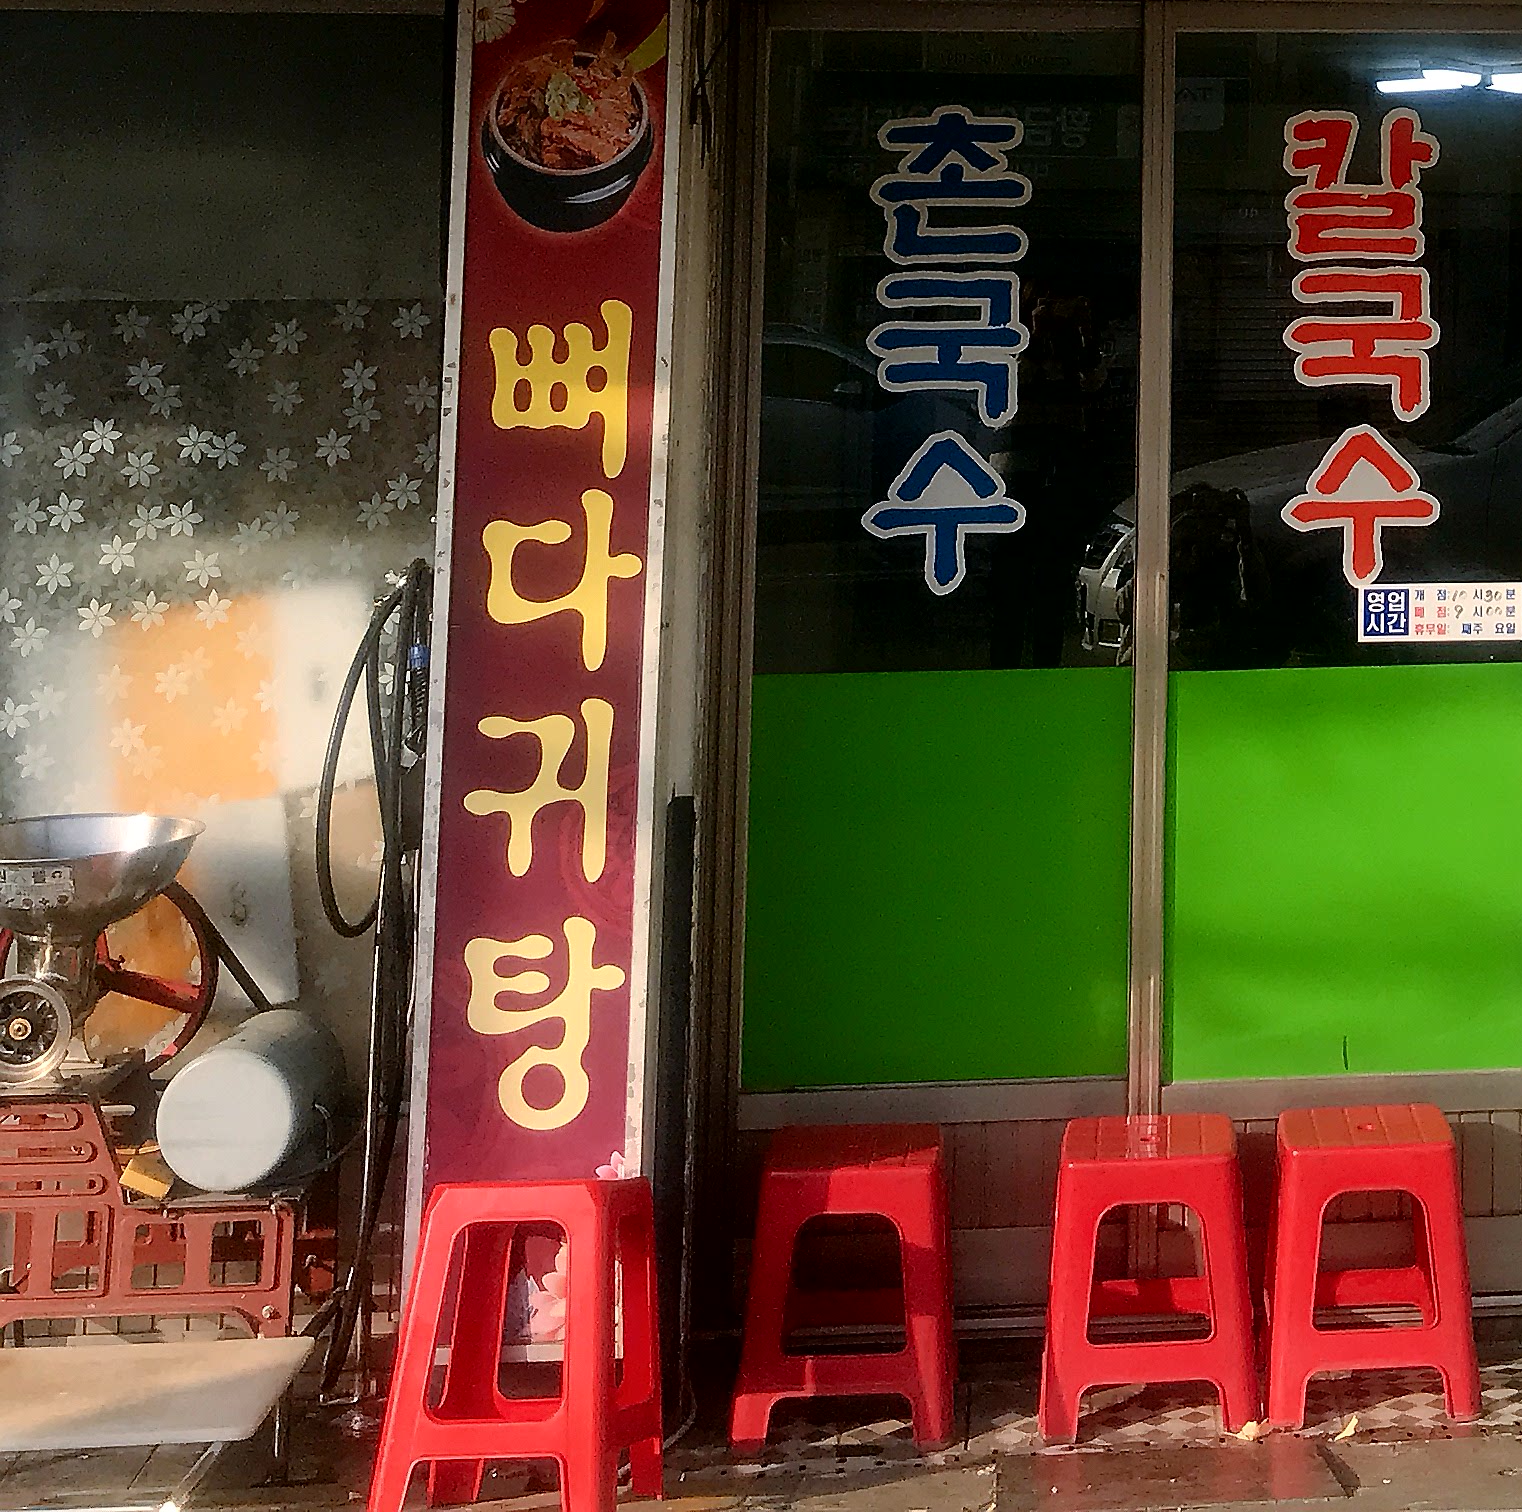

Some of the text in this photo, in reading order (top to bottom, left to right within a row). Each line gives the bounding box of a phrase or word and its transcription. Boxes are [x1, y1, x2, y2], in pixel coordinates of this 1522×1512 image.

[861, 104, 1032, 596] 촌국수
[1281, 107, 1441, 588] 칼국수
[464, 300, 642, 1131] 뼈다귀탕
[1366, 591, 1406, 612] 영업
[1366, 613, 1407, 634] 시간
